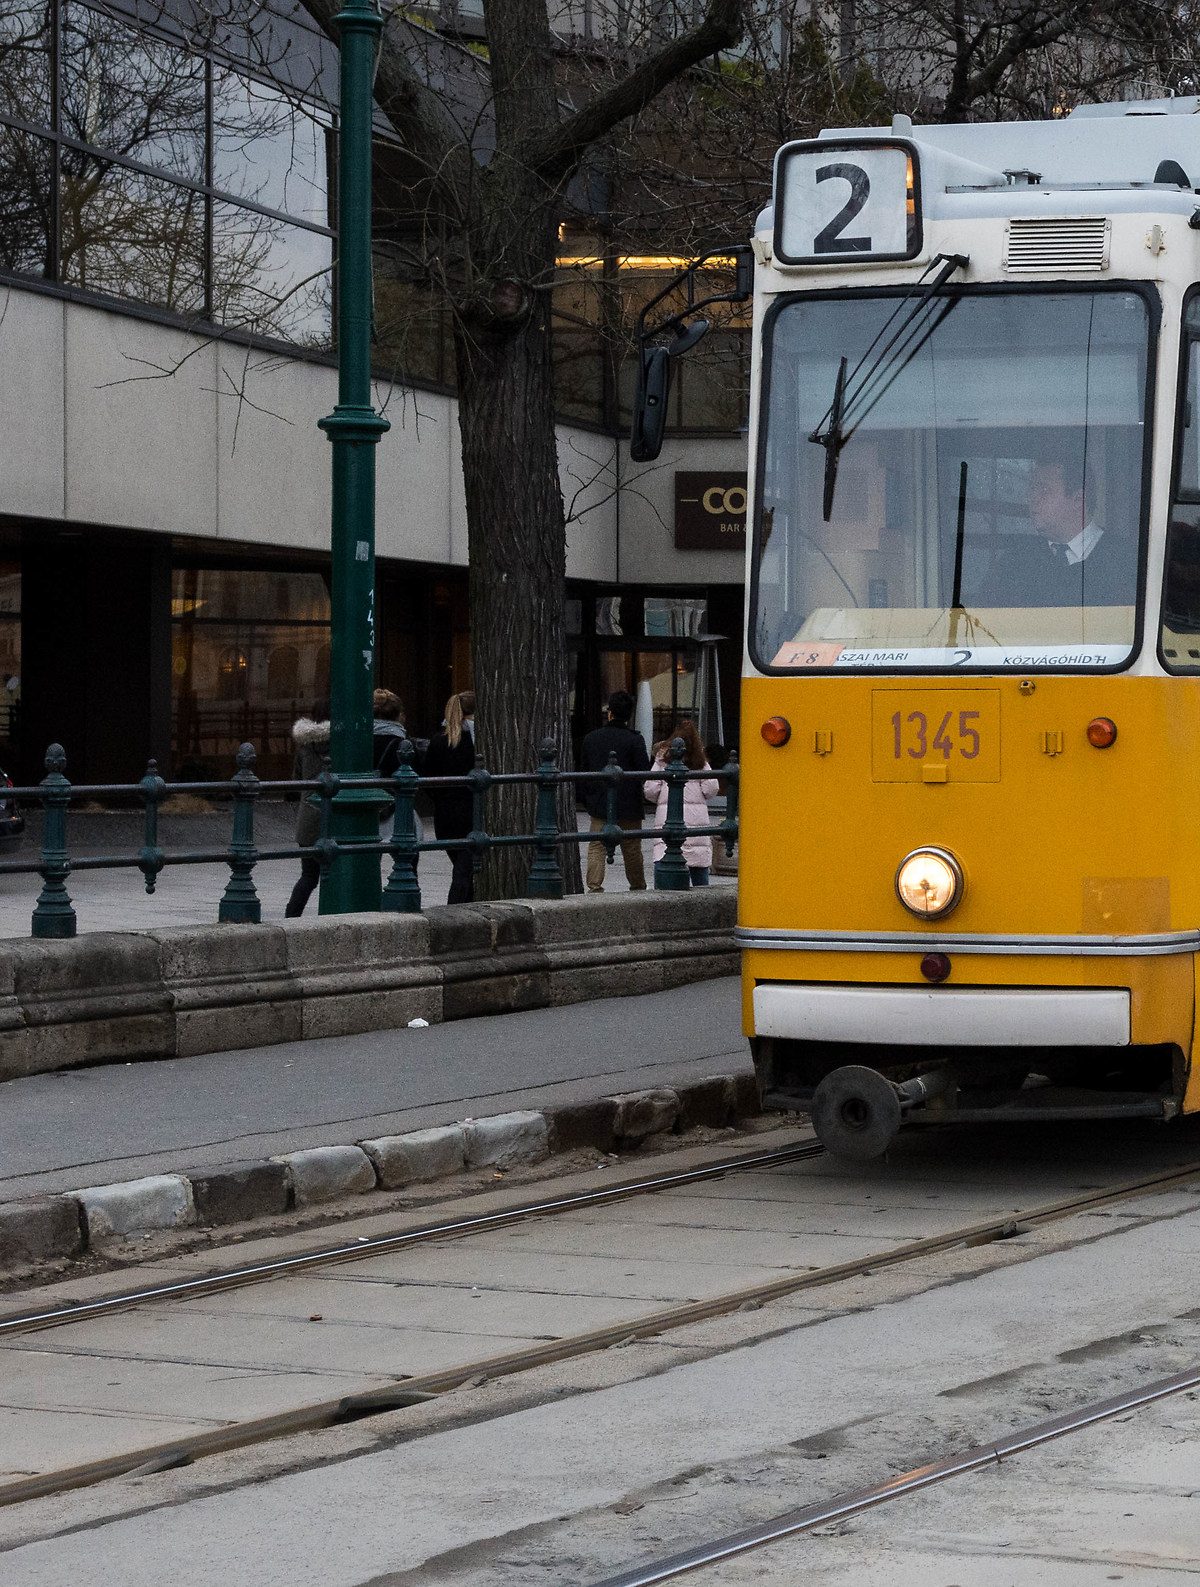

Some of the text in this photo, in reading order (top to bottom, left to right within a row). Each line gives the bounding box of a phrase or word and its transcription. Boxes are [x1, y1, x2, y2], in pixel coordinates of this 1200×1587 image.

[813, 162, 872, 254] 2
[702, 486, 748, 515] CO
[720, 523, 740, 532] BAR
[806, 653, 819, 664] 8
[836, 652, 909, 662] SZAI MARI
[951, 650, 973, 666] 2
[1003, 655, 1092, 665] KÖZVÁGÓHÍD
[891, 711, 980, 760] 1345
